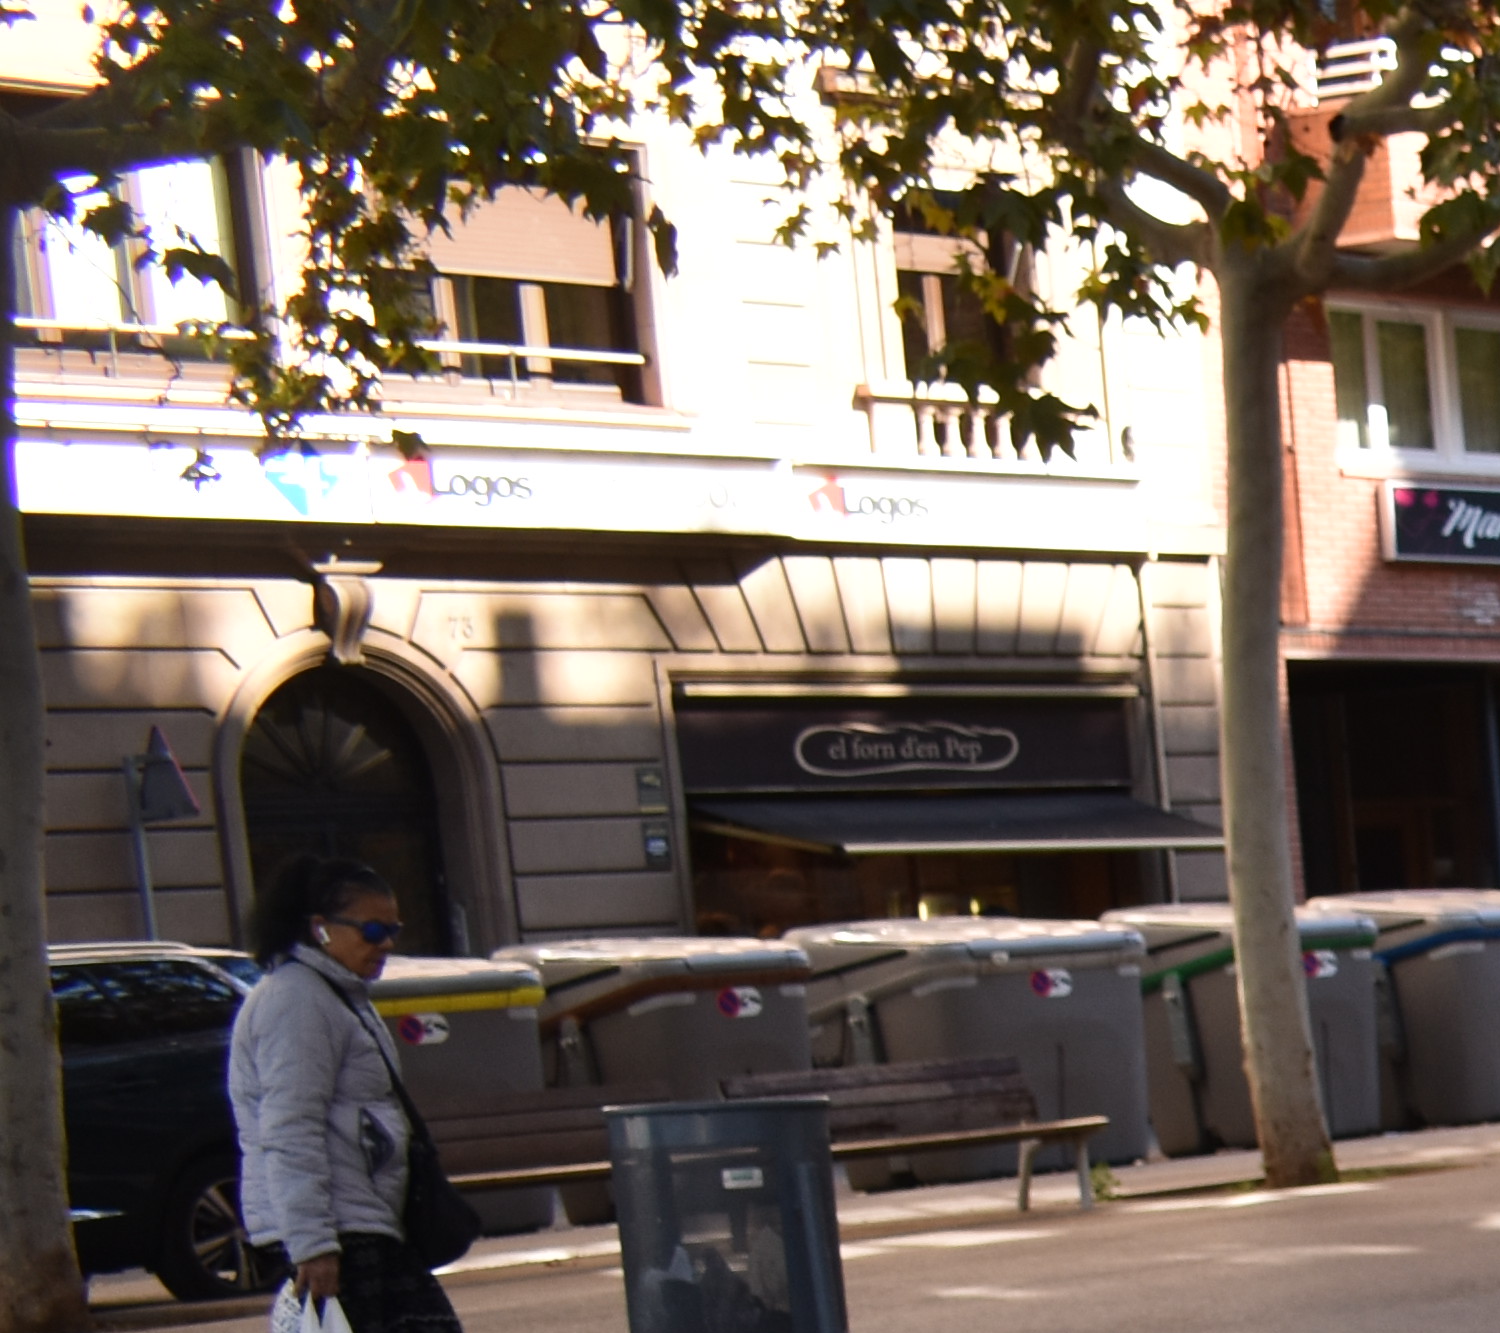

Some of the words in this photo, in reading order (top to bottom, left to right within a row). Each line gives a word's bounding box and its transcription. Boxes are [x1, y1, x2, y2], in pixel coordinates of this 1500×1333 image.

[432, 473, 533, 506] Logos
[843, 486, 929, 524] Logos
[828, 738, 847, 760] el
[853, 736, 895, 760] forn
[944, 736, 982, 764] Pep
